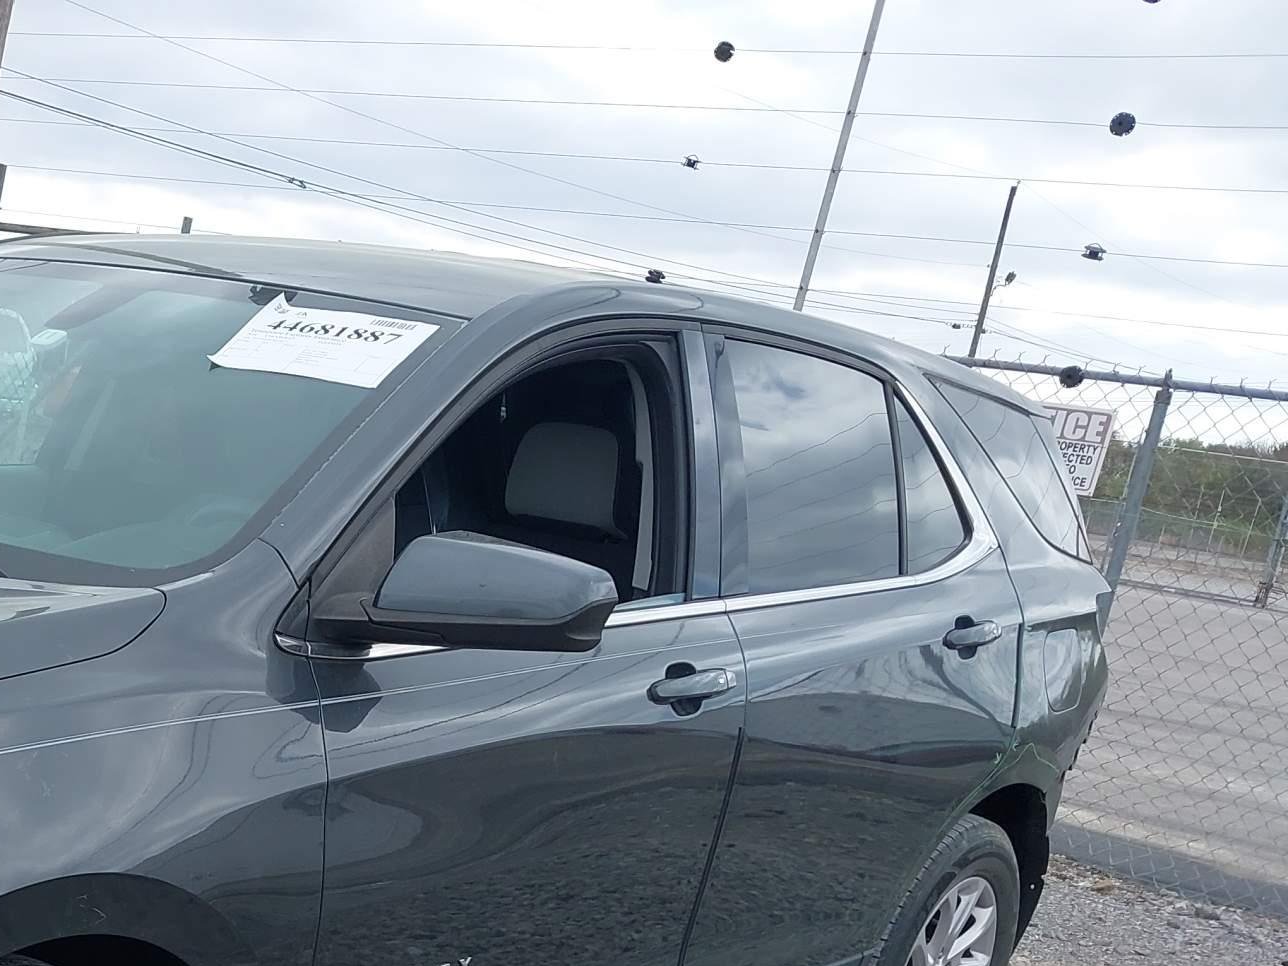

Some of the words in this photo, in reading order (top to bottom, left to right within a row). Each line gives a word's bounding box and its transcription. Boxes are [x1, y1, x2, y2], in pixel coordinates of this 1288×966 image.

[267, 319, 403, 345] 44681887
[1050, 409, 1108, 442] ICE
[1057, 440, 1100, 456] OPERTY
